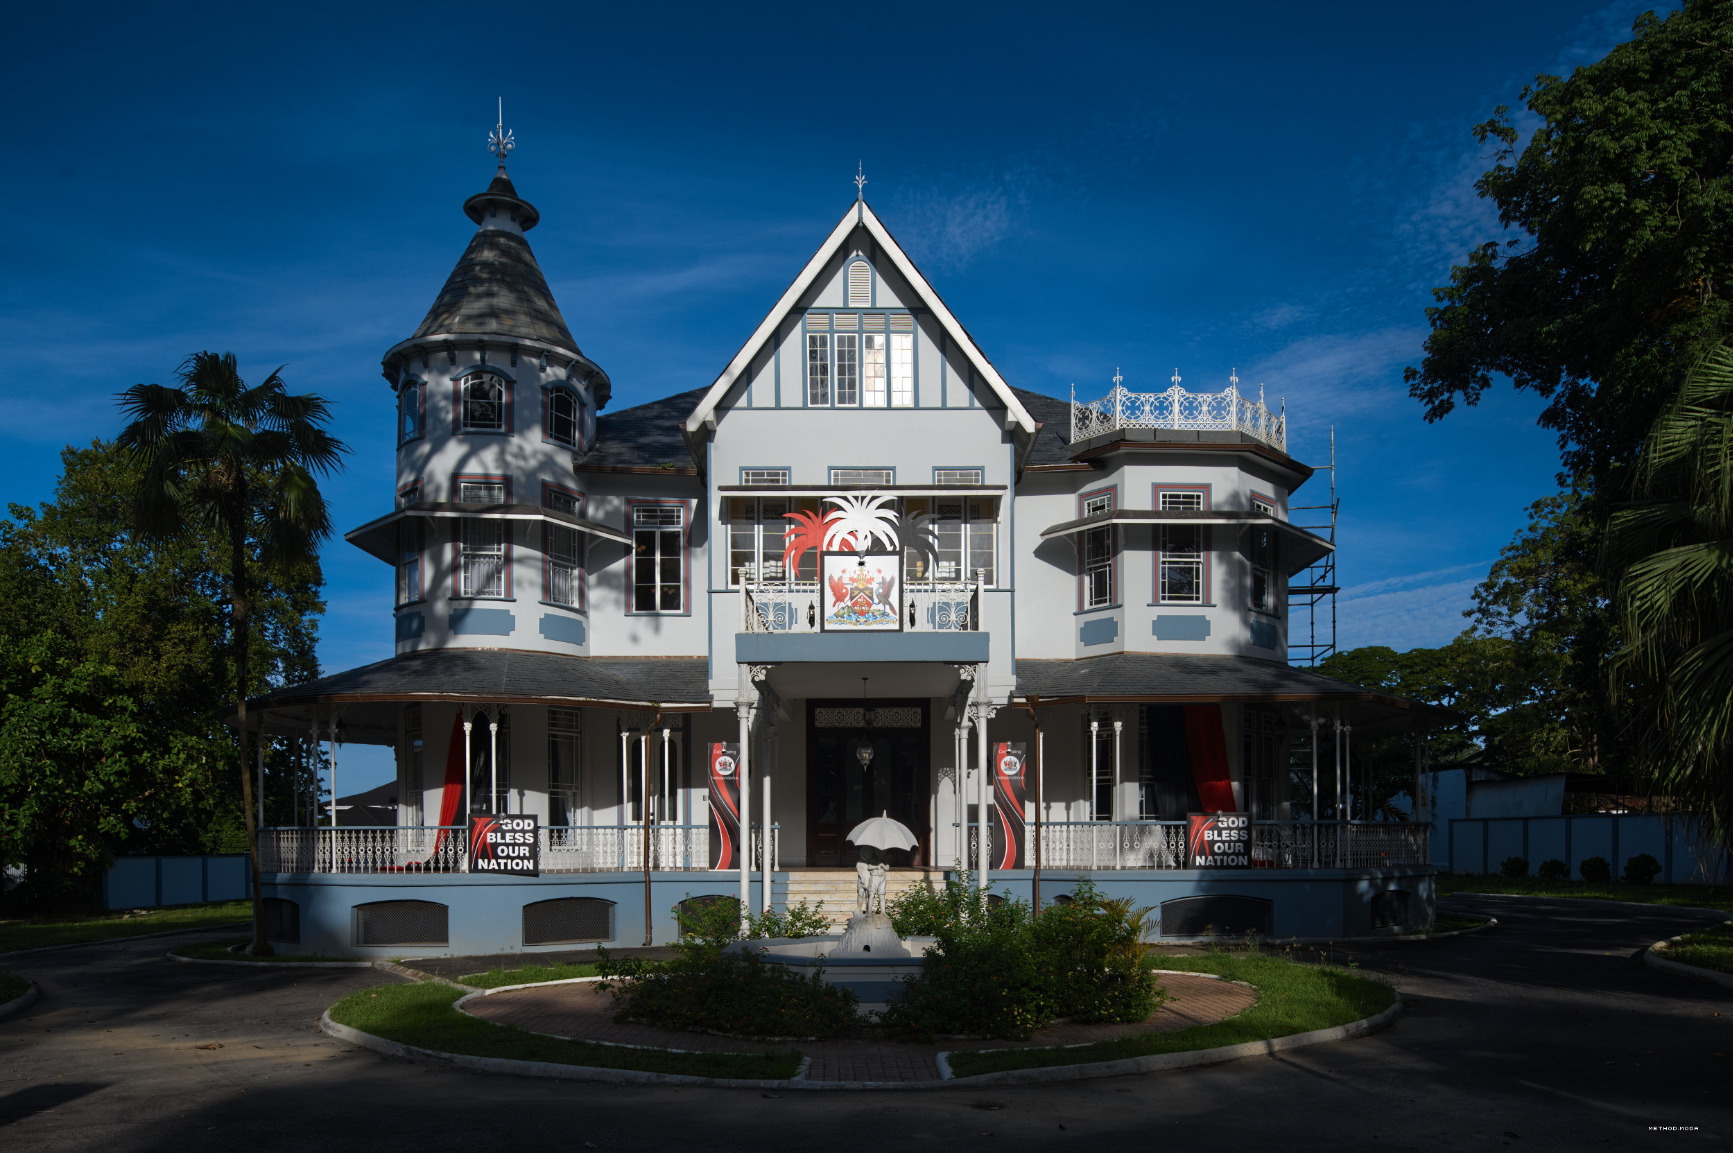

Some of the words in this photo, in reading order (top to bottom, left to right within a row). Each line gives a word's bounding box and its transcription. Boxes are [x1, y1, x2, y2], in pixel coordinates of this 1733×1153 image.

[502, 819, 534, 830] GOD
[1217, 817, 1248, 828] GOD
[486, 832, 534, 843] BLESS
[1204, 830, 1248, 840] BLESS
[497, 846, 530, 857] OUR
[1214, 843, 1244, 853] OUR
[478, 859, 534, 870] NATION
[1195, 855, 1248, 866] NATION
